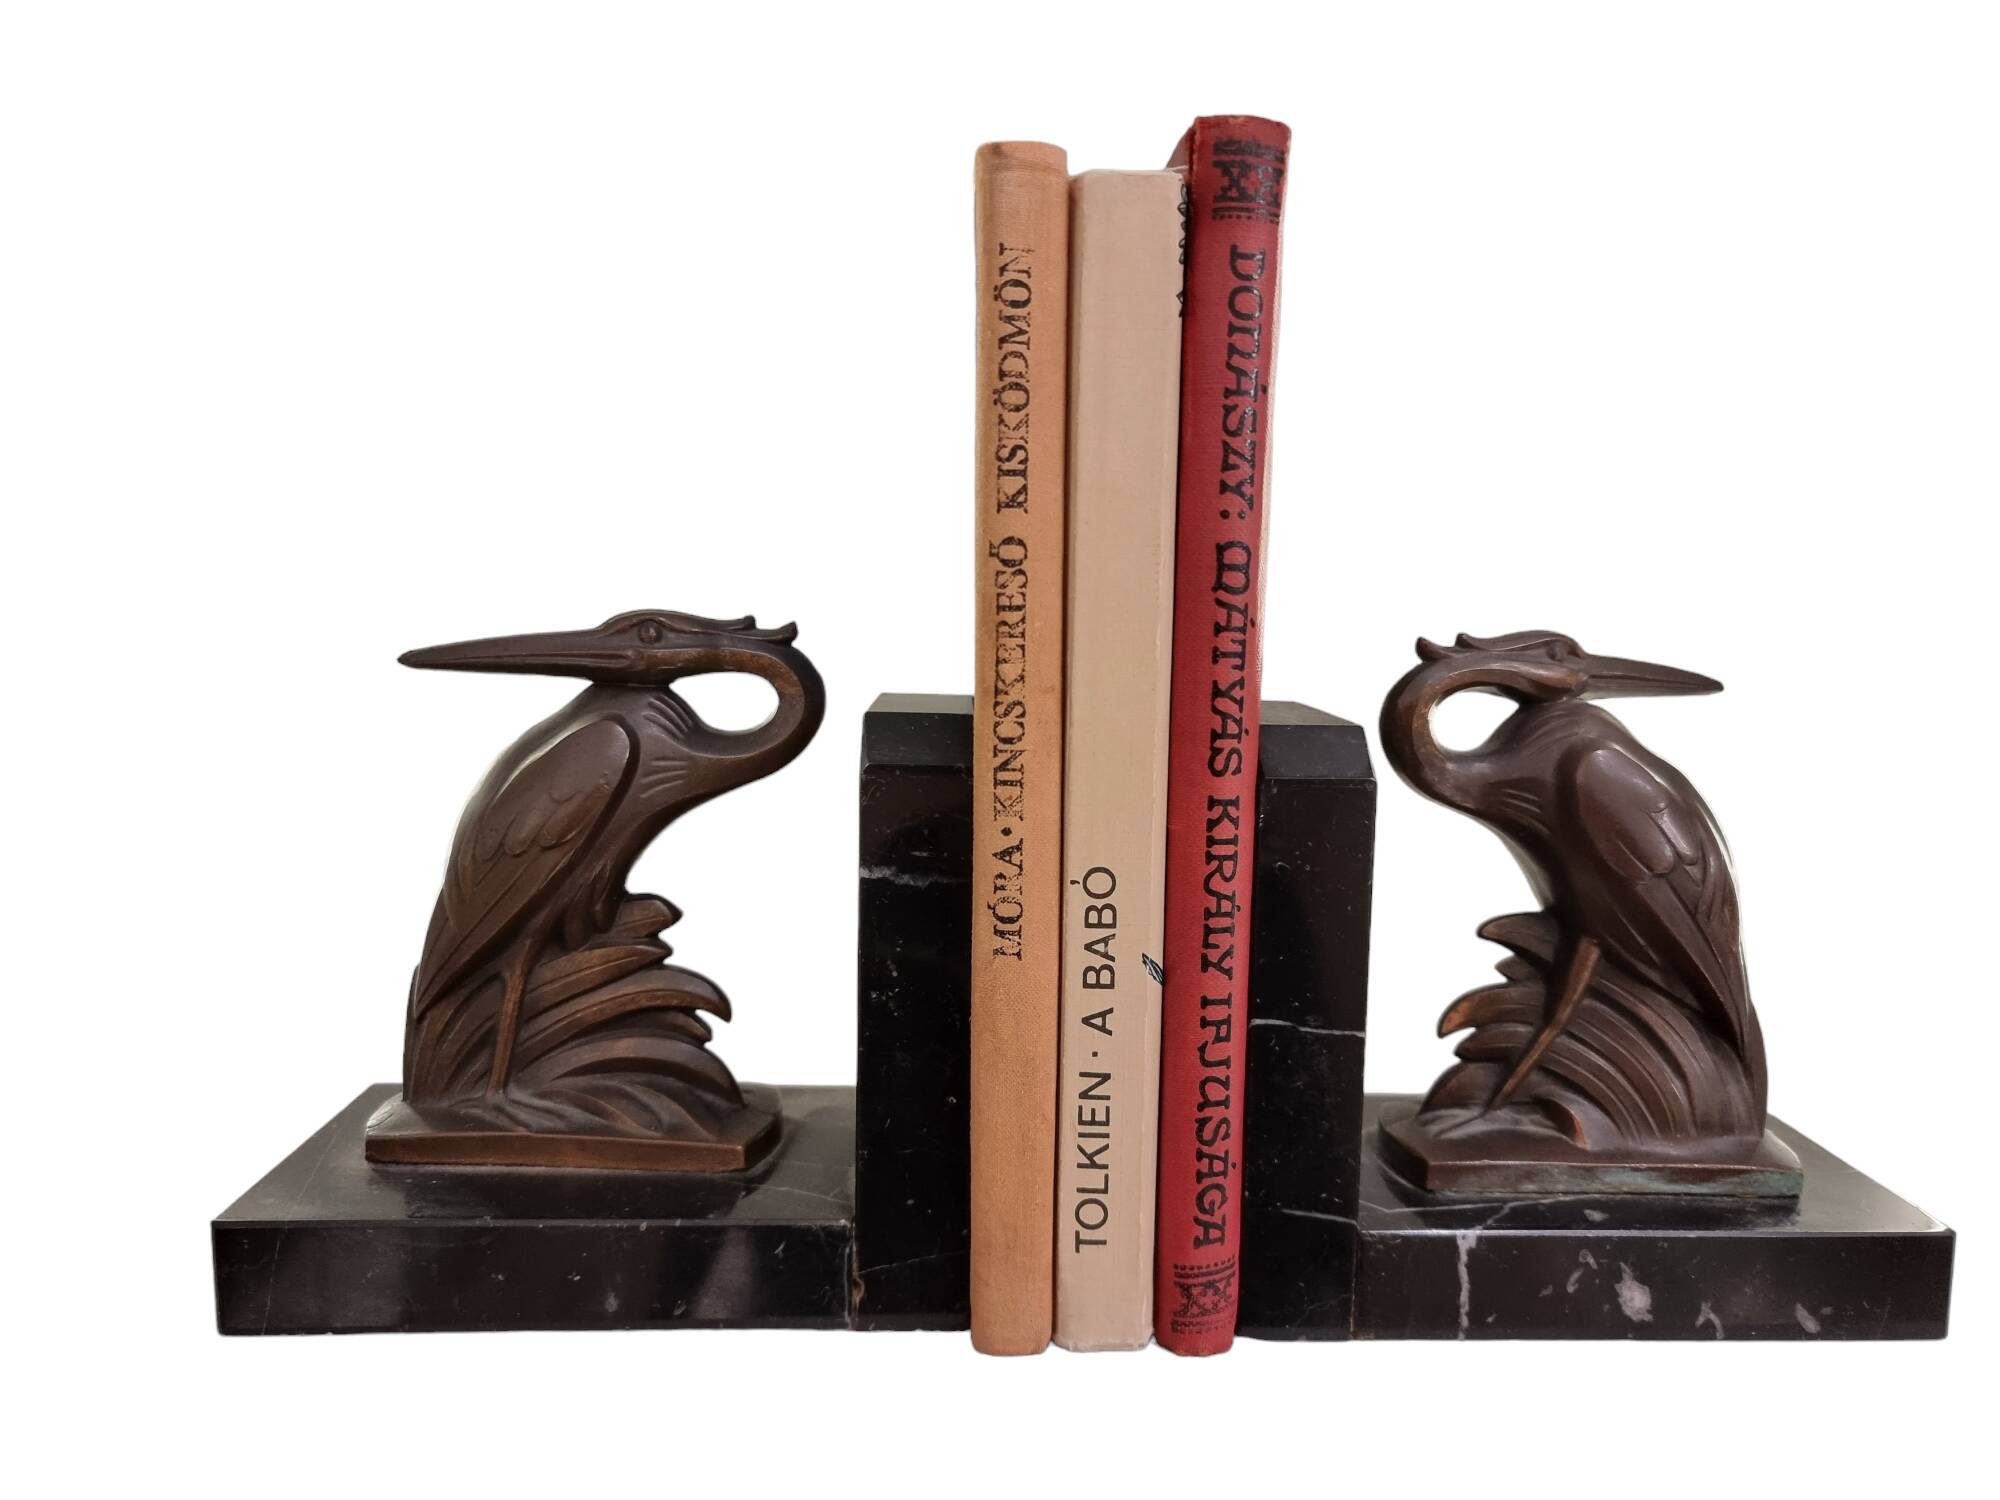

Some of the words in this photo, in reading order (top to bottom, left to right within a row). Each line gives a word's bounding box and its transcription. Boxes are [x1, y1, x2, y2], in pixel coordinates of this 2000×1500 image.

[993, 242, 1036, 514] KISKÖDMÖN
[1219, 244, 1267, 520] DONÁSZY:
[989, 535, 1028, 822] KINCSKERESŐ
[1208, 540, 1256, 778] MÁTYÁS
[987, 838, 1024, 961] MÓRA
[1070, 866, 1117, 989] BABÓ
[1200, 795, 1241, 981] KIRÁLY
[1081, 1007, 1114, 1036] A
[1193, 993, 1236, 1250] IFJUSÁGA
[1075, 1071, 1112, 1253] TOLKIEN
